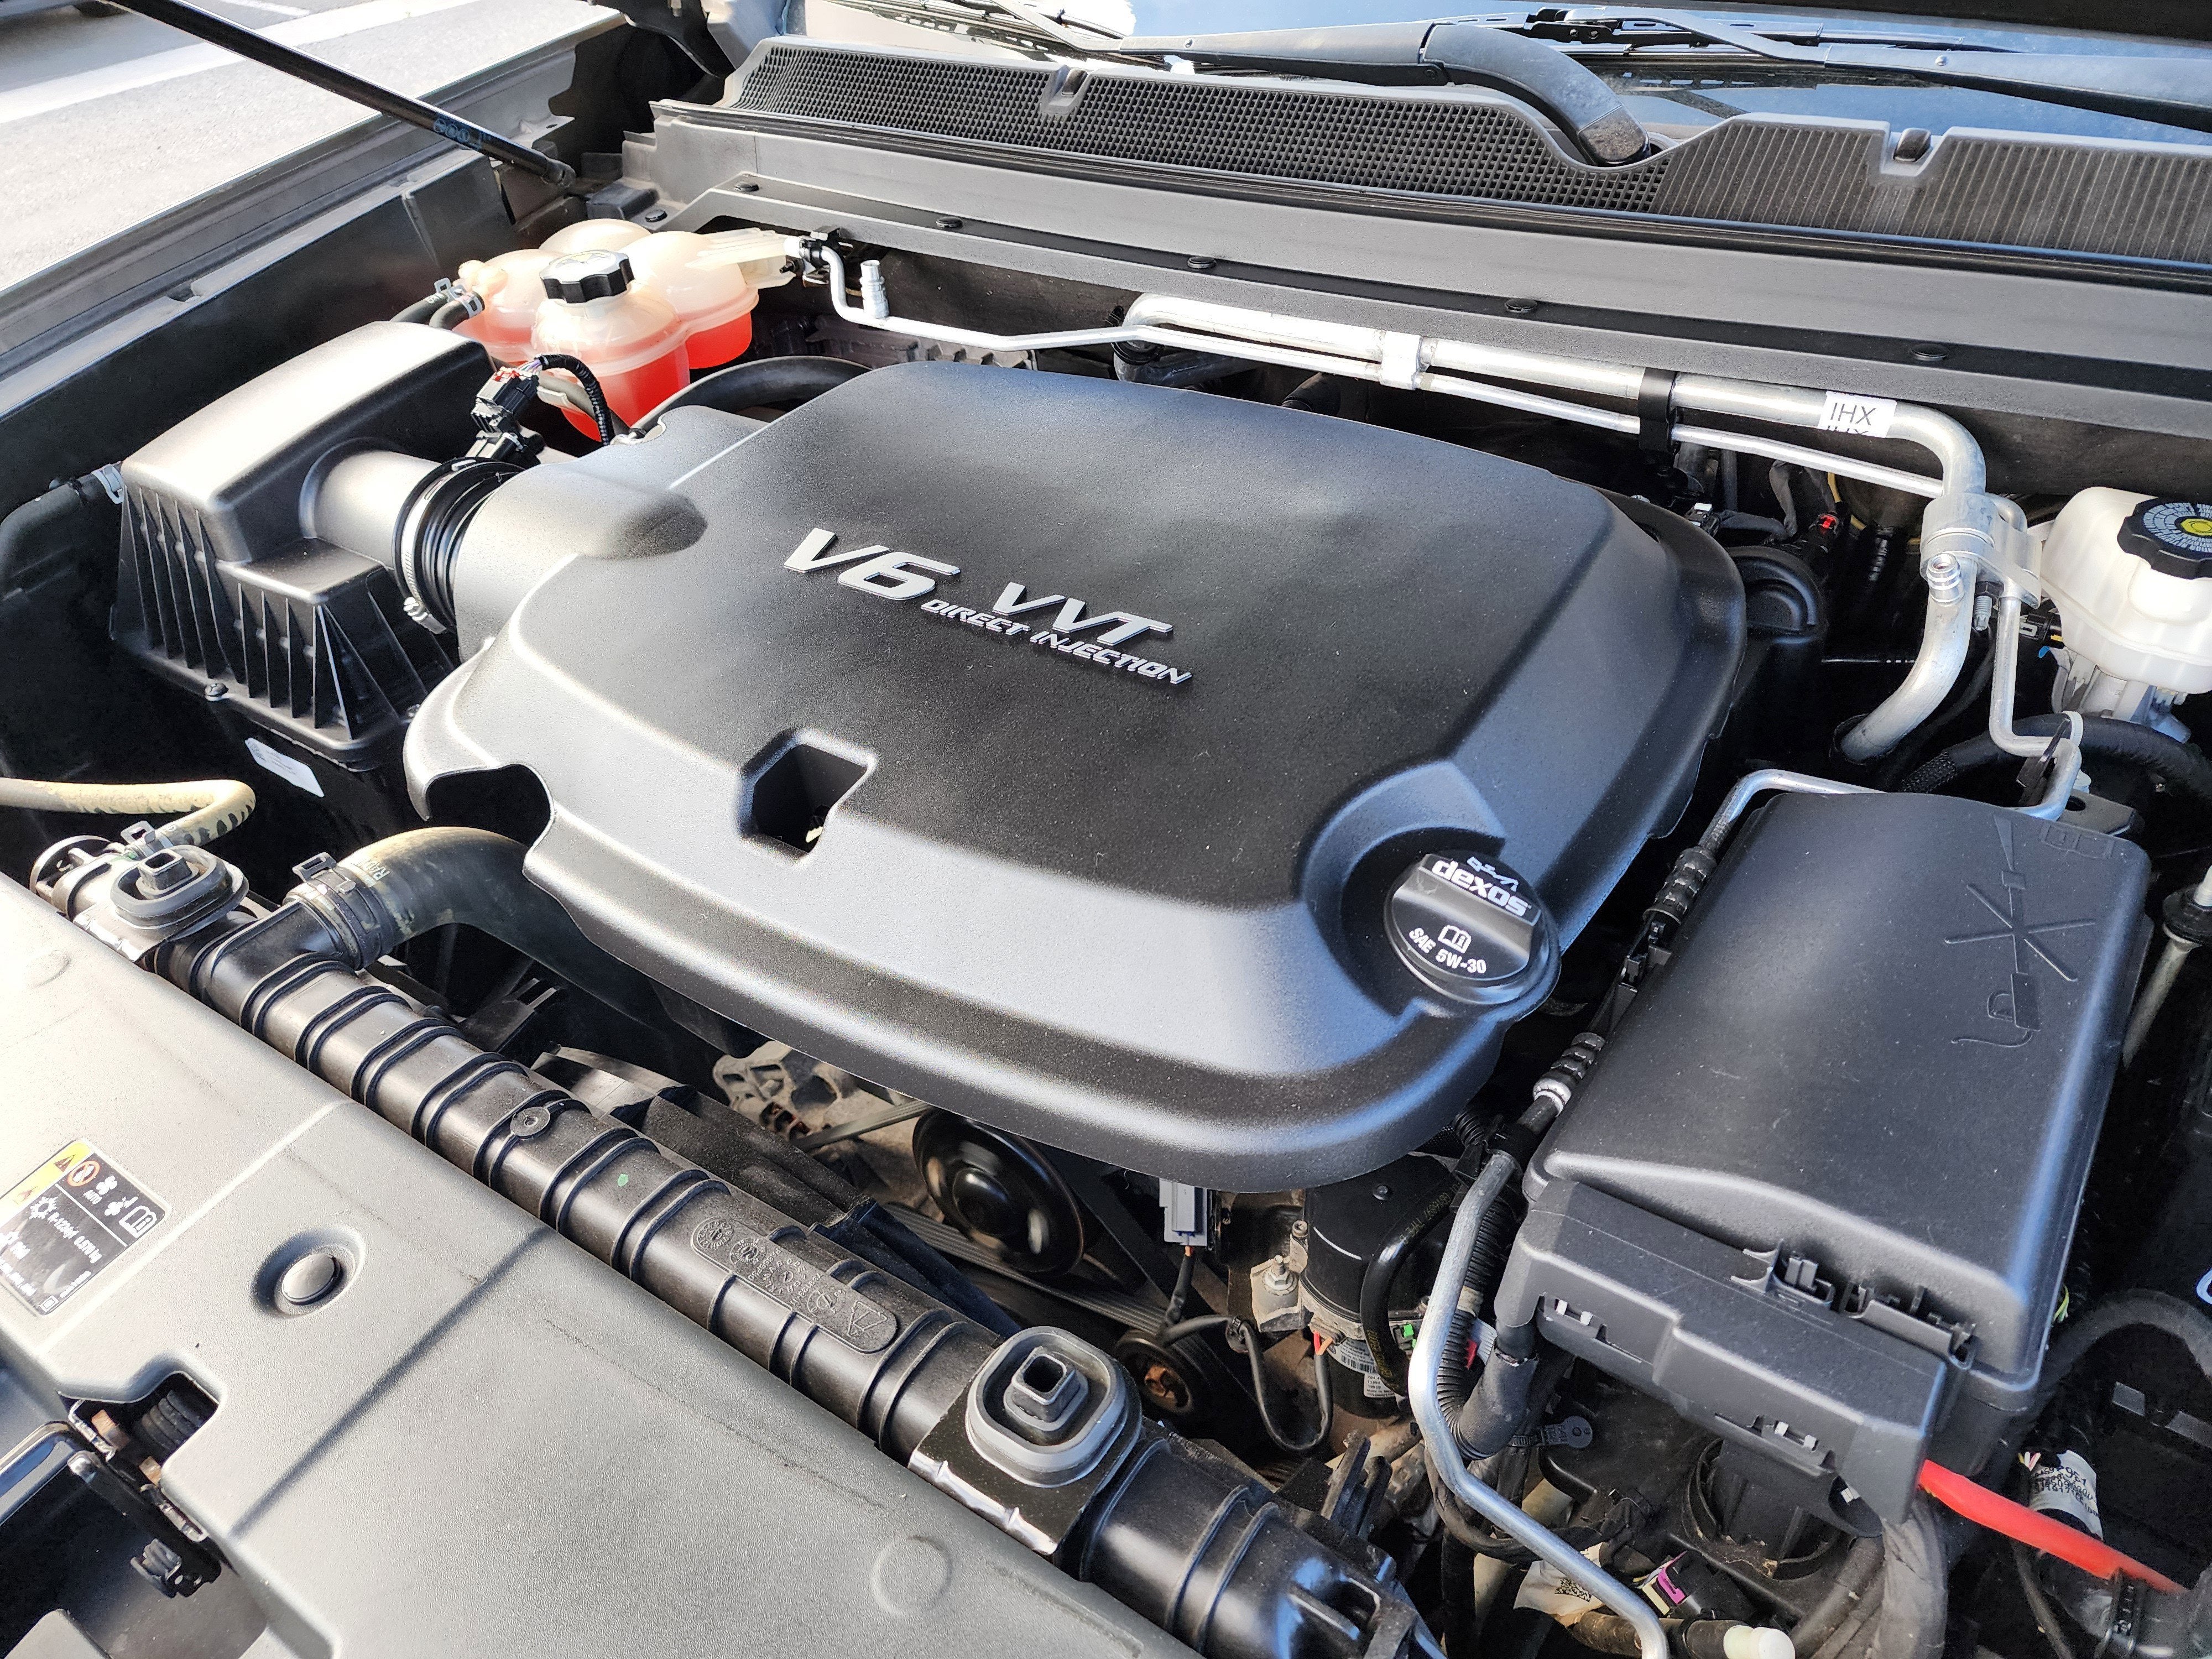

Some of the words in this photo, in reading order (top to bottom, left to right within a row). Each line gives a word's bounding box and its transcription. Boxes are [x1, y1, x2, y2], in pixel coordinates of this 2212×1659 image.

[1830, 402, 1877, 425] IHX
[784, 528, 961, 601] V6
[993, 582, 1173, 646] VVT
[921, 599, 1031, 635] DIRECT
[1029, 630, 1192, 684] INJECTION
[1432, 860, 1528, 916] dexos
[1409, 927, 1436, 953] SAE
[1436, 948, 1486, 974] 5W-30
[83, 1190, 102, 1204] AUTO
